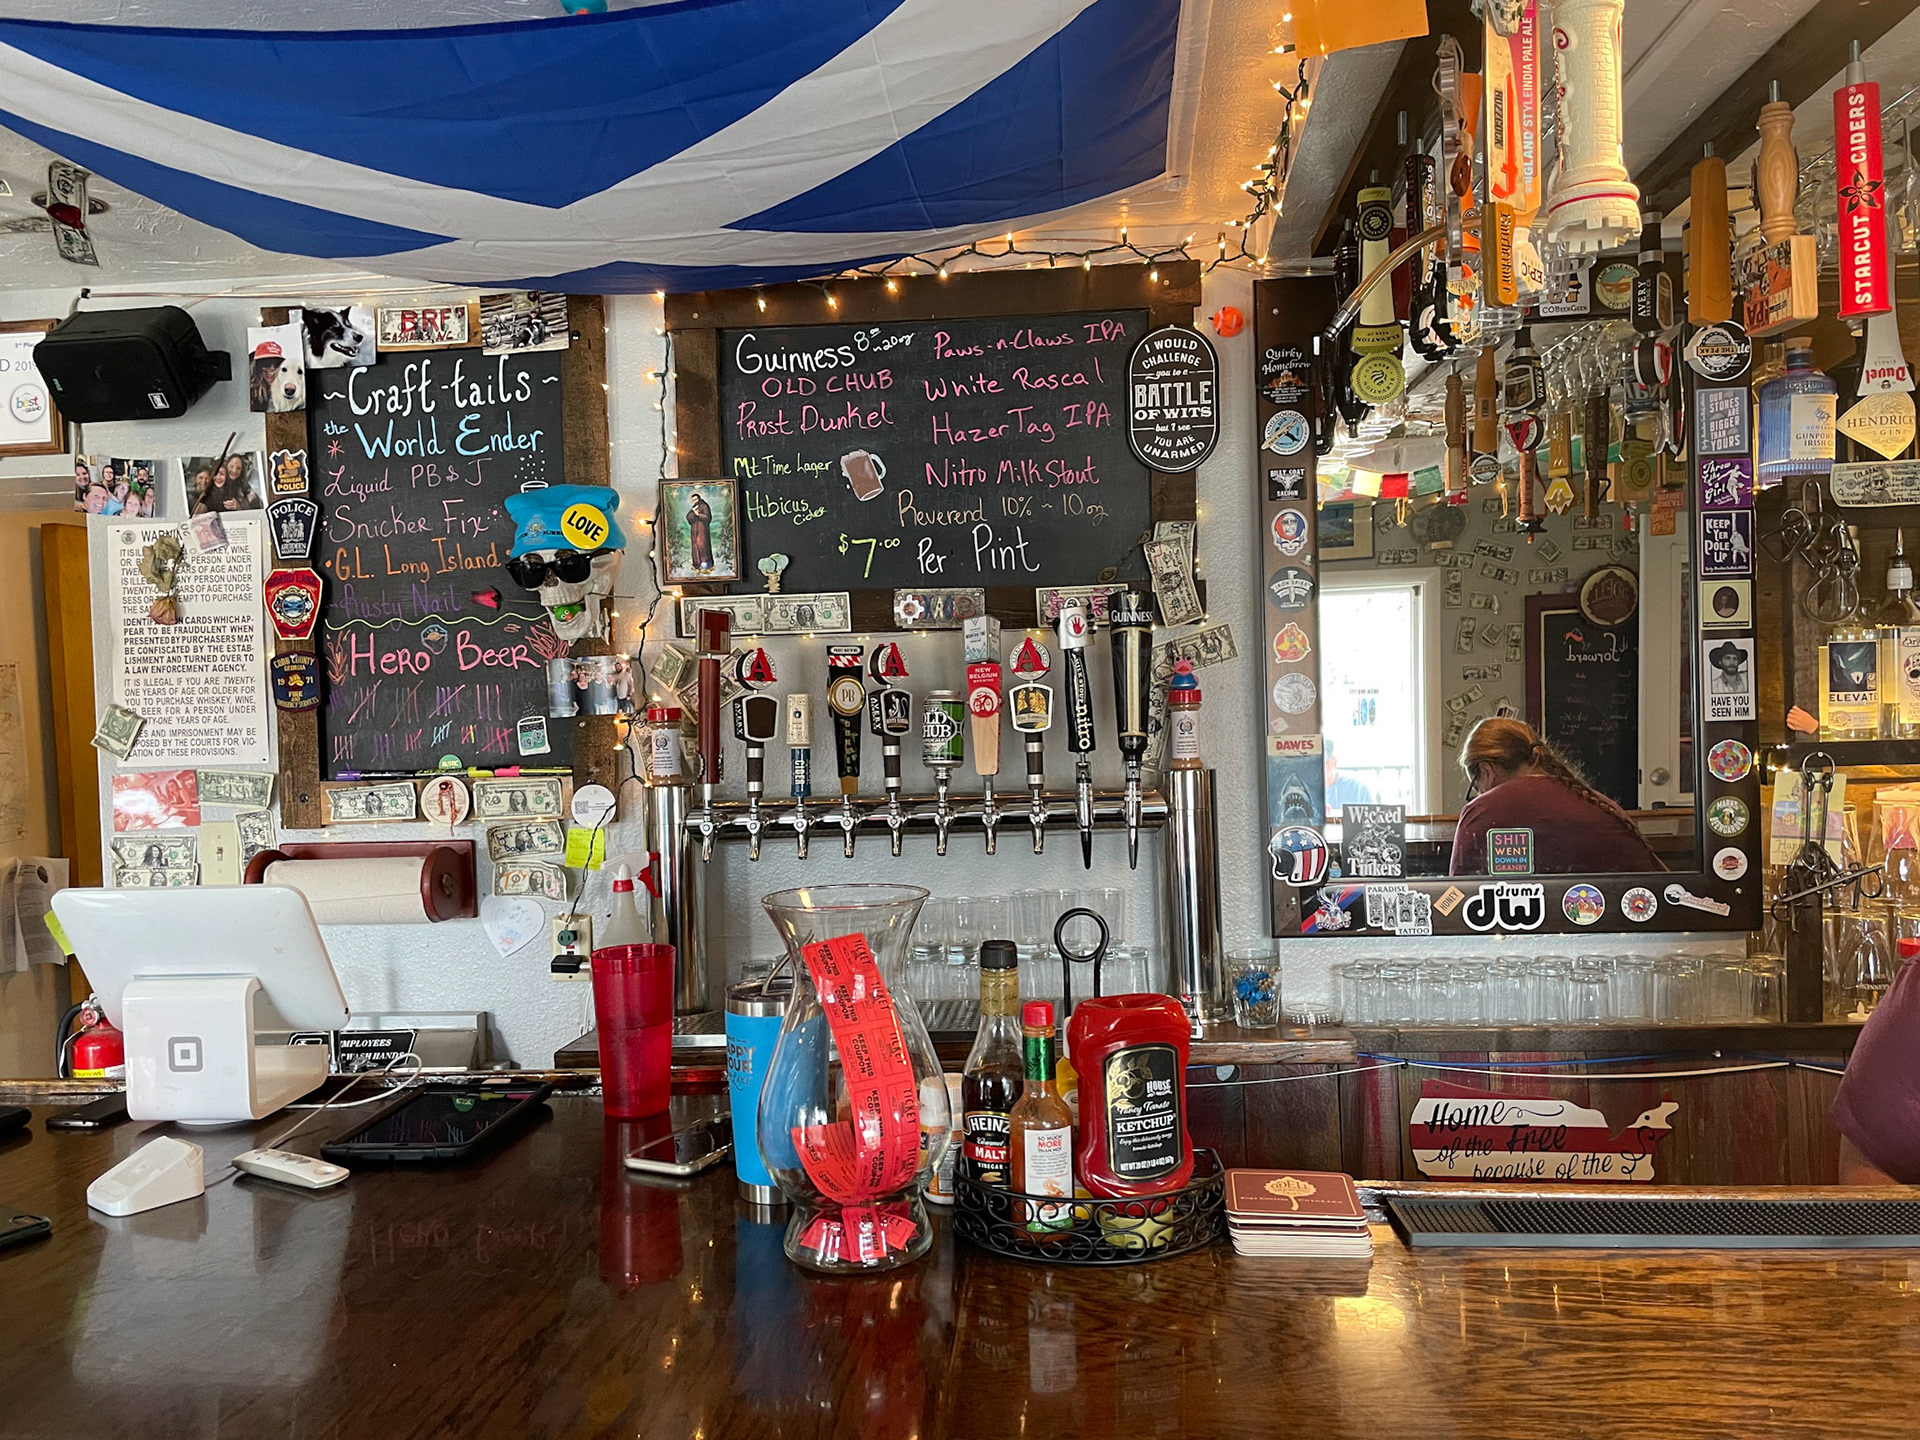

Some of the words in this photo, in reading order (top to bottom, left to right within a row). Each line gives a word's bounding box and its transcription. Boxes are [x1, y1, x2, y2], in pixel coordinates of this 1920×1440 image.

[1522, 17, 1533, 36] ALE
[1522, 39, 1533, 61] PALE
[1523, 65, 1533, 91] INDIA
[1850, 93, 1866, 164] CIDERS
[1853, 215, 1872, 304] STARCUT
[1638, 281, 1646, 317] AVERY
[1083, 319, 1126, 344] IPA
[736, 333, 856, 374] Guinness
[1144, 342, 1150, 353] I
[1154, 338, 1198, 351] WOULD
[1142, 353, 1202, 369] CHALLENGE
[1266, 348, 1303, 360] Quirky
[1156, 369, 1171, 379] you
[1172, 368, 1181, 376] to
[1262, 359, 1311, 375] Homebrew
[1865, 366, 1906, 384] Duvel
[761, 376, 817, 398] OLD
[826, 369, 894, 393] CHUB
[924, 375, 1004, 402] White
[1012, 357, 1104, 391] Rascal
[1134, 381, 1212, 408] BATTLE
[1709, 391, 1723, 400] OUR
[1709, 398, 1739, 411] STONES
[1727, 408, 1740, 416] ARE
[800, 401, 894, 434] Dunkel
[1063, 400, 1111, 429] IPA
[1134, 409, 1160, 421] OF
[1161, 406, 1212, 420] WITS
[323, 421, 349, 435] the
[1155, 424, 1169, 432] but
[1710, 418, 1740, 431] BIGGER
[1879, 428, 1901, 436] GIN
[354, 416, 445, 459] World
[455, 411, 544, 456] Ender
[1154, 436, 1174, 448] YOU
[1176, 434, 1196, 446] ARE
[1710, 429, 1727, 439] THAN
[1143, 441, 1205, 459] UNARMED
[1710, 436, 1741, 451] YOURS
[1804, 439, 1826, 447] IRISH
[762, 455, 792, 476] Time
[797, 456, 833, 481] Lager
[925, 457, 986, 488] Nitro
[996, 456, 1042, 486] Milk
[1045, 456, 1099, 488] Stout
[1270, 470, 1286, 478] BILLY
[1287, 468, 1305, 476] GOAT
[1703, 460, 1731, 477] Throw
[277, 482, 305, 490] POLICE
[324, 465, 393, 502] Liquid
[1276, 489, 1299, 497] SALOON
[1705, 485, 1725, 504] Girl
[272, 503, 314, 519] POLICE
[898, 489, 988, 528] Reverend
[1002, 496, 1033, 518] 10%
[441, 499, 489, 539] Fix
[567, 510, 604, 542] LOVE
[1705, 519, 1731, 532] KEEP
[1713, 529, 1729, 540] YER
[917, 536, 947, 575] Per
[972, 522, 1040, 574] Pint
[1704, 540, 1730, 555] POLE
[384, 543, 430, 584] Long
[431, 538, 502, 574] Island
[411, 583, 462, 614] Nail
[1111, 610, 1153, 623] GUINNESS
[124, 628, 144, 636] PEAR
[161, 627, 171, 635] BE
[174, 626, 226, 634] FRAUDULENT
[230, 625, 253, 633] WHEN
[124, 647, 135, 655] BE
[138, 645, 190, 655] CONFISCATED
[193, 645, 203, 653] BY
[208, 645, 224, 653] THE
[227, 644, 253, 652] ESTAB-
[278, 678, 285, 686] 19
[842, 689, 855, 702] PB
[1711, 696, 1731, 706] HAVE
[1732, 695, 1750, 706] YOU
[735, 702, 743, 735] AVERY
[870, 697, 881, 730] AVERY
[1711, 707, 1732, 717] SEEN
[1734, 706, 1750, 717] HIM
[1076, 704, 1092, 749] nitro
[1276, 740, 1314, 751] DAWES
[794, 759, 805, 785] CIDER
[1716, 798, 1739, 810] MARKS
[1348, 806, 1402, 824] Wicked
[1709, 812, 1746, 834] BEERGARDEN
[1494, 833, 1527, 846] SHIT
[1495, 847, 1527, 855] WENT
[1348, 858, 1402, 877] Tinkers
[1495, 885, 1540, 897] drums
[1439, 889, 1458, 911] HONEY
[1398, 927, 1430, 935] TATTOO
[853, 939, 872, 965] TICKET
[818, 949, 832, 975] COUPON
[822, 944, 833, 961] KEEP
[831, 961, 840, 977] THIS
[1147, 1079, 1171, 1094] HOUSE
[970, 1118, 1010, 1132] HEINZ
[1116, 1115, 1174, 1133] KETCHUP
[1424, 1100, 1505, 1135] Home
[977, 1137, 1004, 1146] Gourmet
[1436, 1141, 1461, 1170] of
[1465, 1135, 1493, 1158] the
[1506, 1123, 1568, 1156] Free
[975, 1147, 1007, 1160] MALT
[978, 1162, 1003, 1170] VINEGAR
[1473, 1155, 1545, 1183] because
[1555, 1152, 1578, 1181] of
[1582, 1151, 1614, 1175] the
[1271, 1179, 1309, 1189] ODELL
